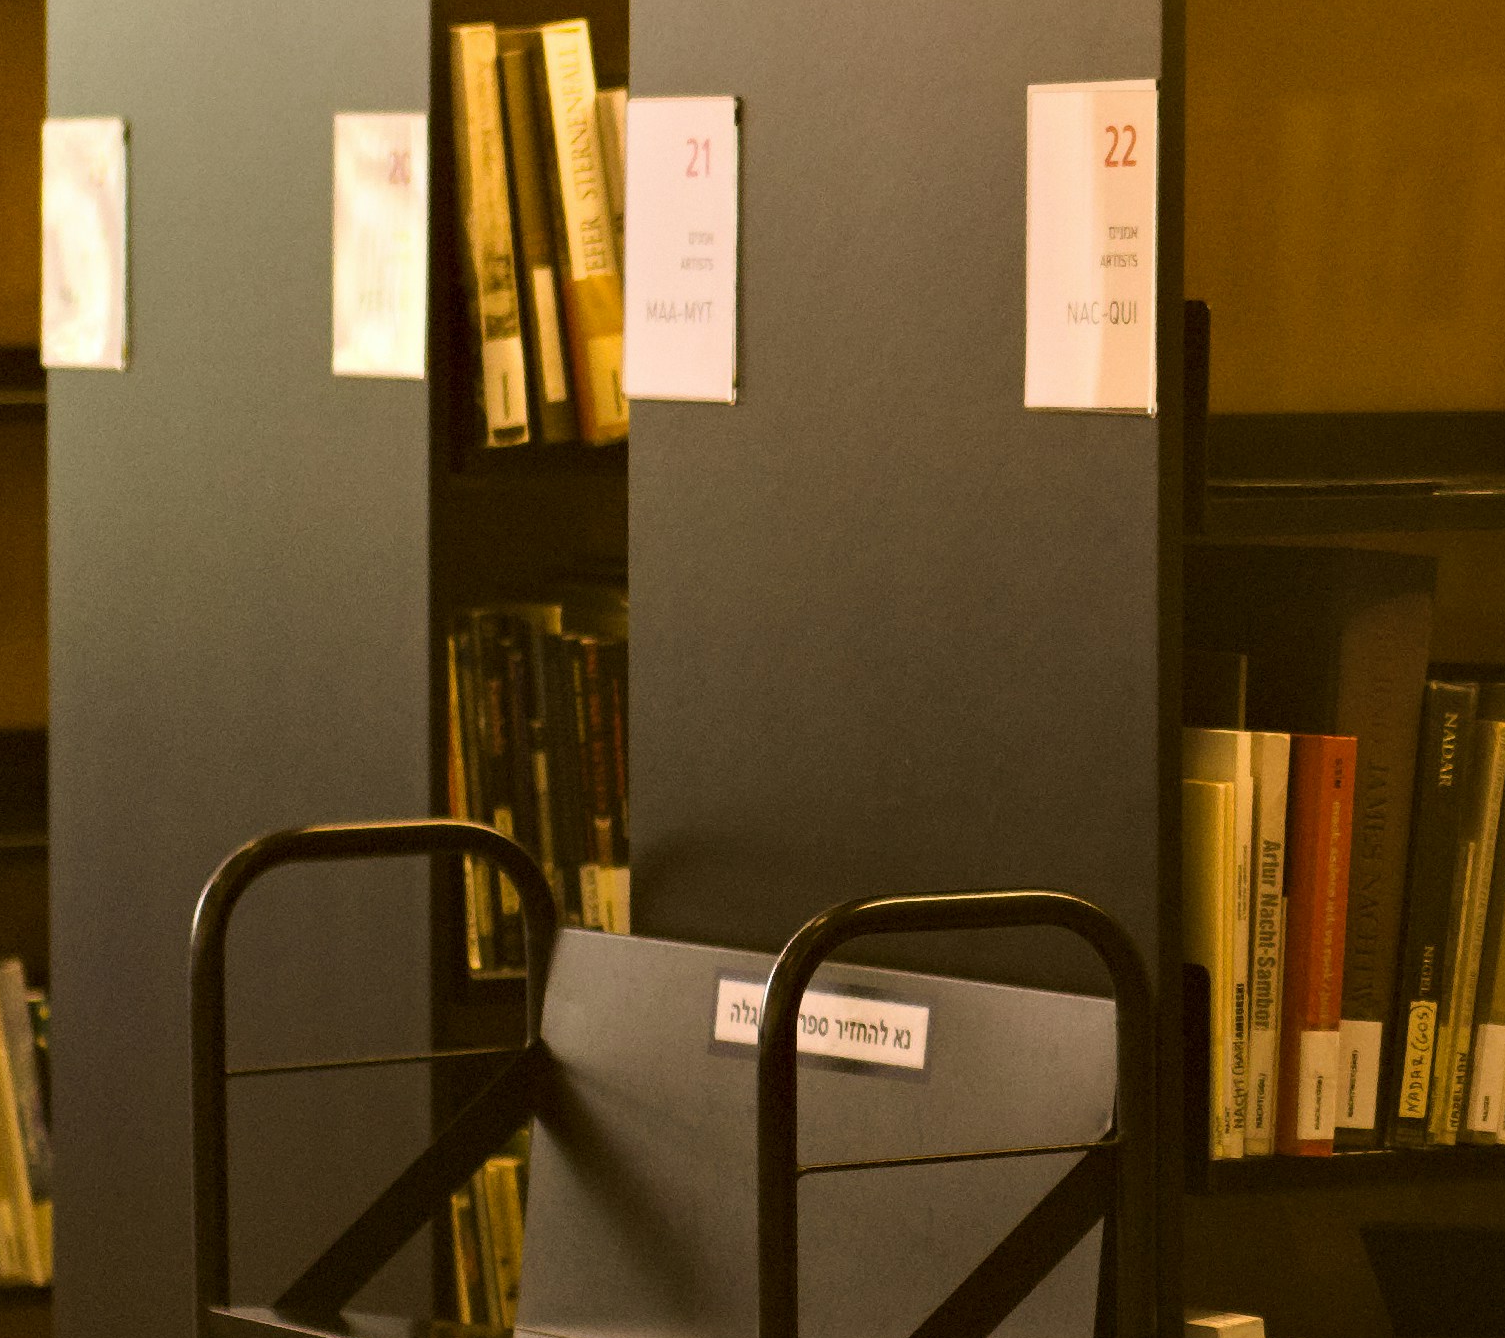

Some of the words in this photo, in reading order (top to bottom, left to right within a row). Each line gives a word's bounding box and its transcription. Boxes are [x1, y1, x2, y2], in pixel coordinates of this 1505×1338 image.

[686, 137, 712, 178] 21
[1104, 125, 1137, 167] 22
[1100, 254, 1138, 268] ARTISTS
[1067, 301, 1137, 325] NAC-QUI
[1437, 712, 1458, 787] NADAR
[1261, 839, 1281, 887] Artur
[730, 999, 758, 1027] גלה
[799, 1013, 828, 1037] ספר
[835, 1019, 888, 1046] להחזיר
[894, 1029, 912, 1050] נא
